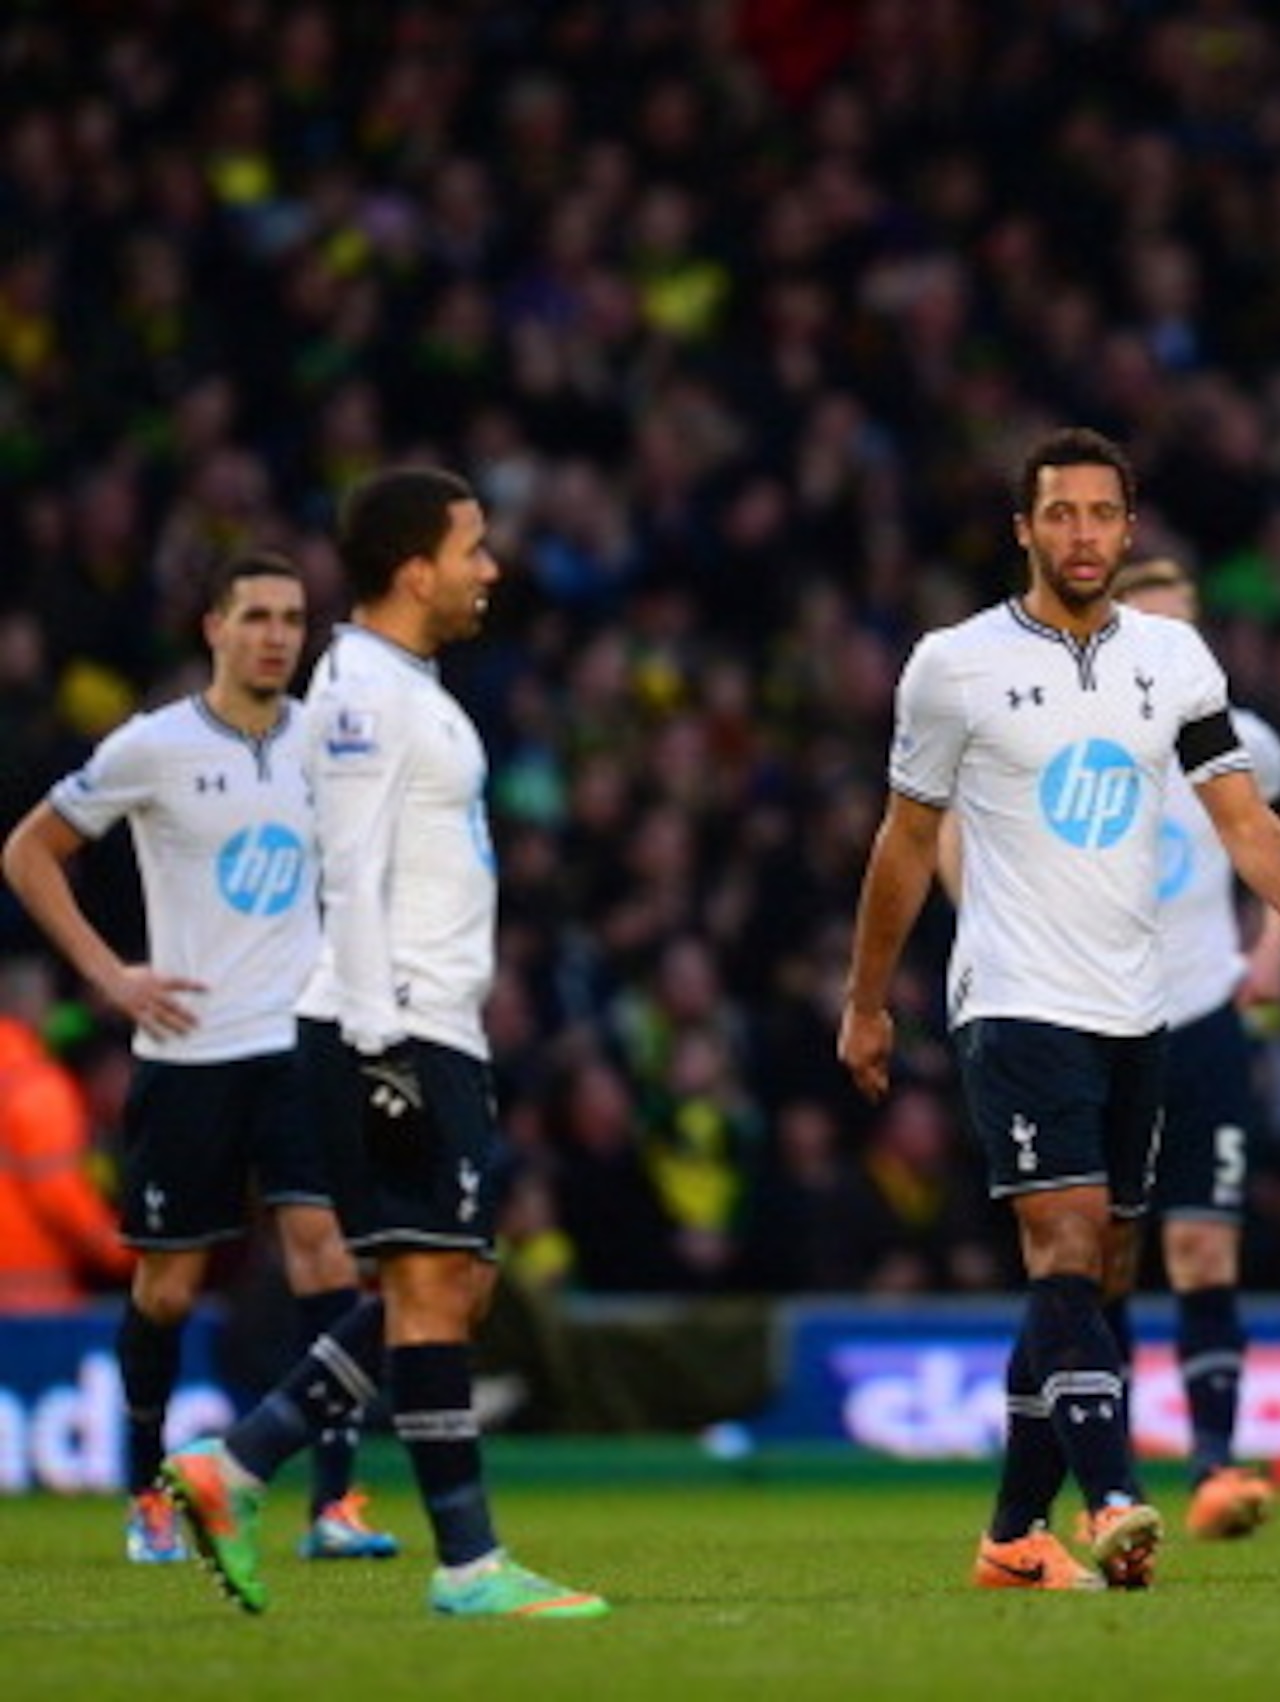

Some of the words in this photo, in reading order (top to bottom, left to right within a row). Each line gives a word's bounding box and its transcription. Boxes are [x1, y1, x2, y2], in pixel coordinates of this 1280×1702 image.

[1051, 736, 1136, 849] hp
[226, 822, 299, 917] hp
[1213, 1123, 1247, 1184] 5
